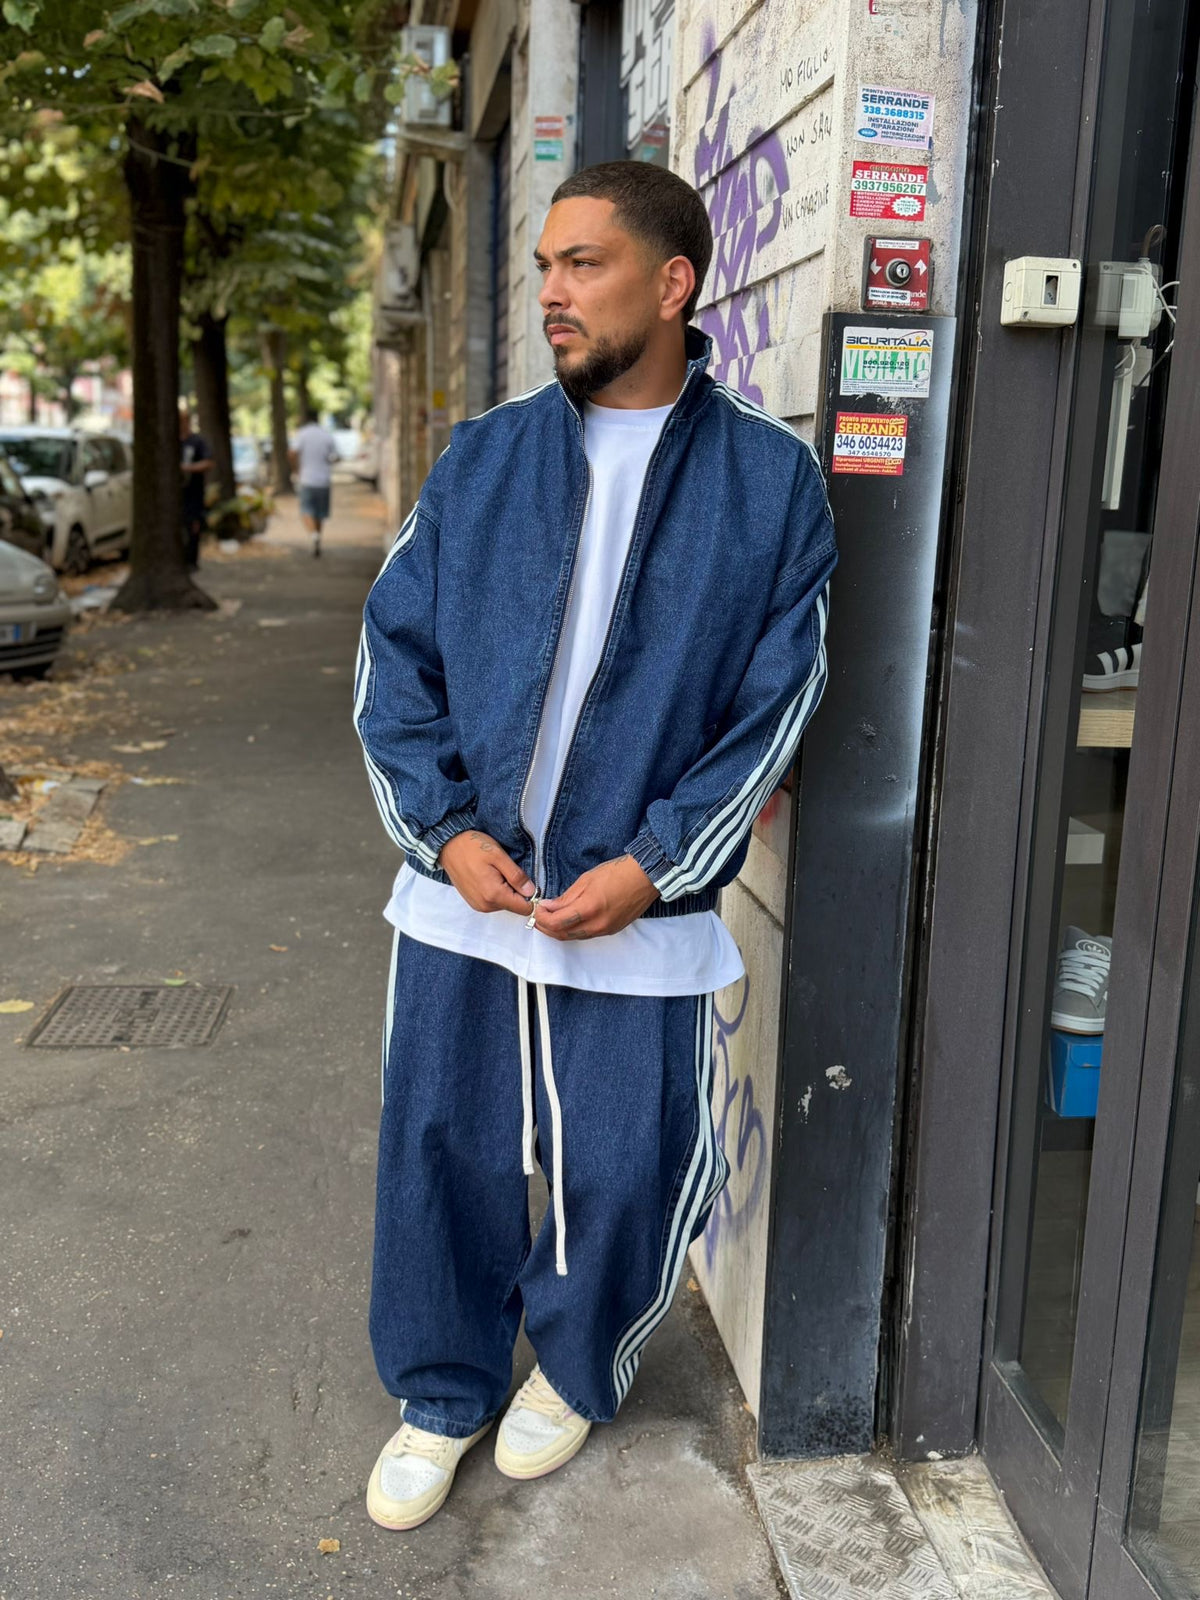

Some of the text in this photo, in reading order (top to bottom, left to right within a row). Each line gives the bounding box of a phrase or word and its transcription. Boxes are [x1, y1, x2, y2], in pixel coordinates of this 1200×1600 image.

[862, 93, 929, 110] SERRANDE
[864, 105, 924, 120] 338.3688315
[868, 117, 918, 128] INSTALLAZIONI
[871, 123, 914, 133] RIPARAZIONI
[855, 170, 924, 182] SERRANDE
[854, 180, 924, 194] 3937956267
[846, 336, 930, 347] SICURITALIA
[844, 350, 931, 380] VIGILATO
[839, 422, 904, 435] SERRANDE
[836, 435, 902, 451] 346 6054423
